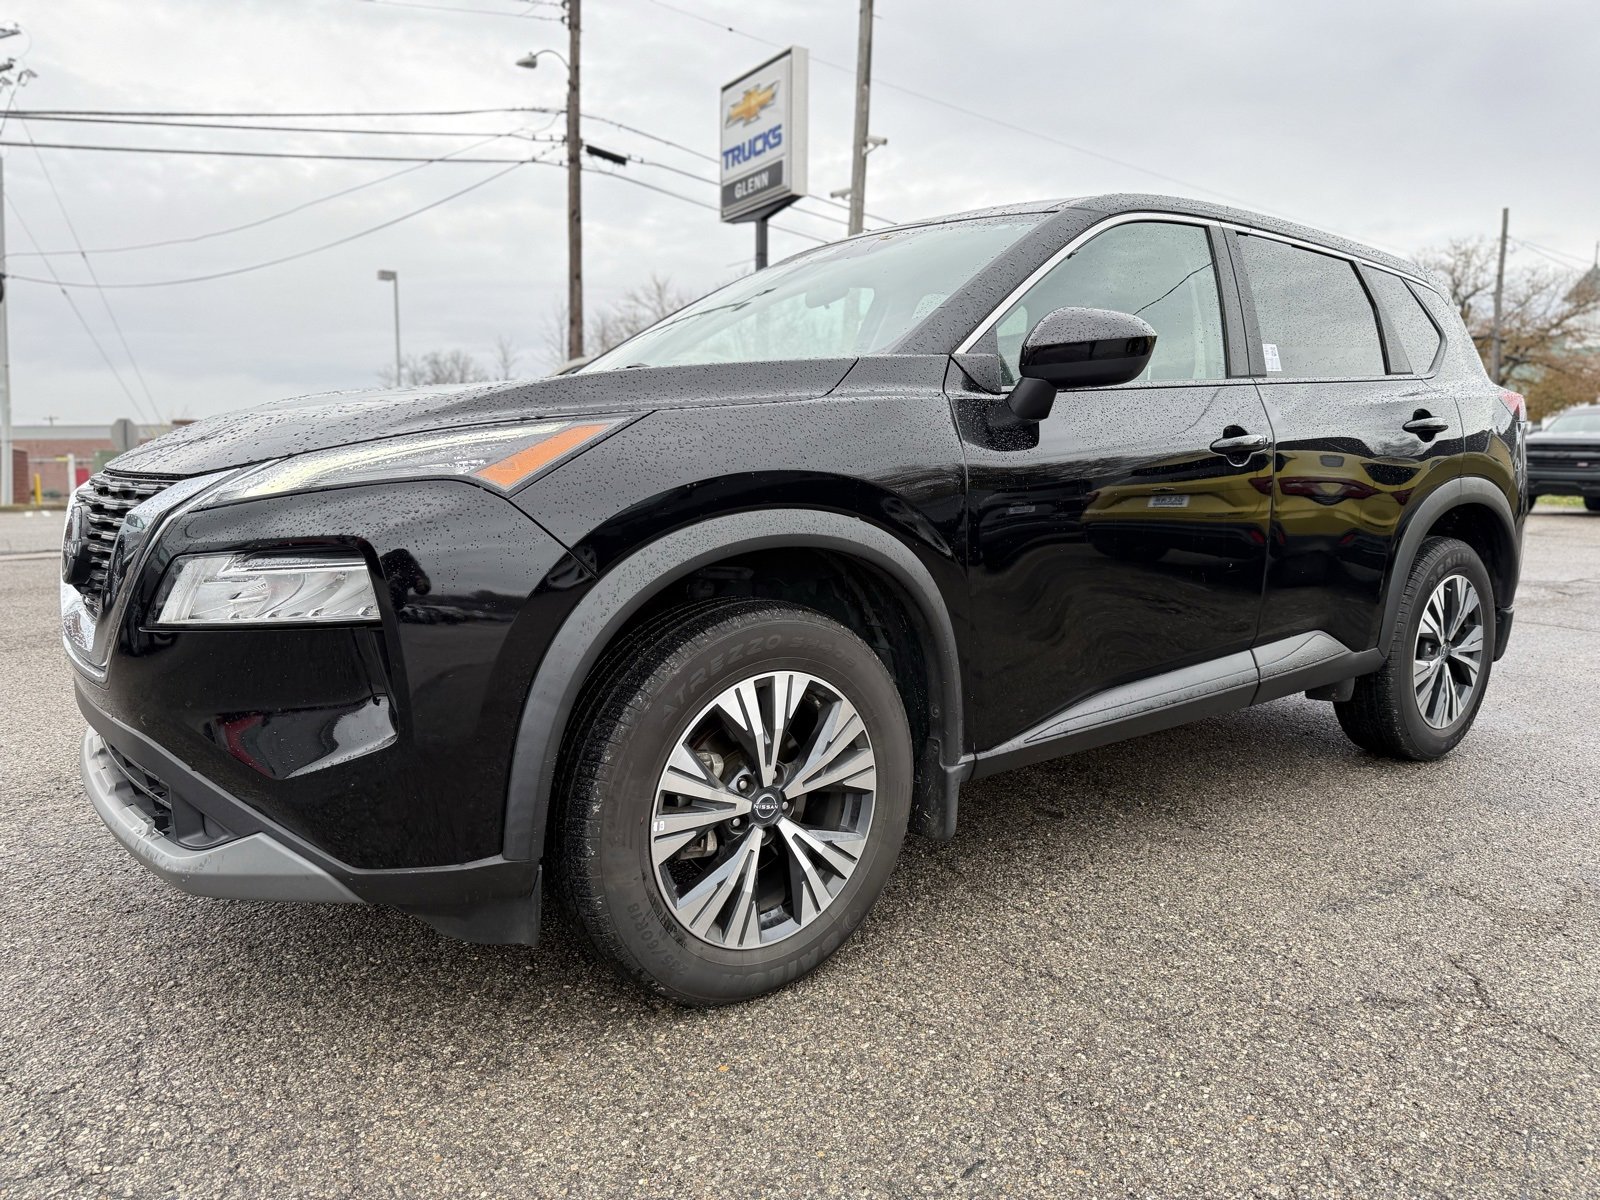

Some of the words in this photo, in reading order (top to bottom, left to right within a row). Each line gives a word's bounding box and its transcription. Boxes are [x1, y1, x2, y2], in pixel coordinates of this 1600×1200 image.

[722, 124, 783, 171] TRUCKS
[734, 171, 769, 199] GLENN
[663, 633, 783, 721] ATREZZO
